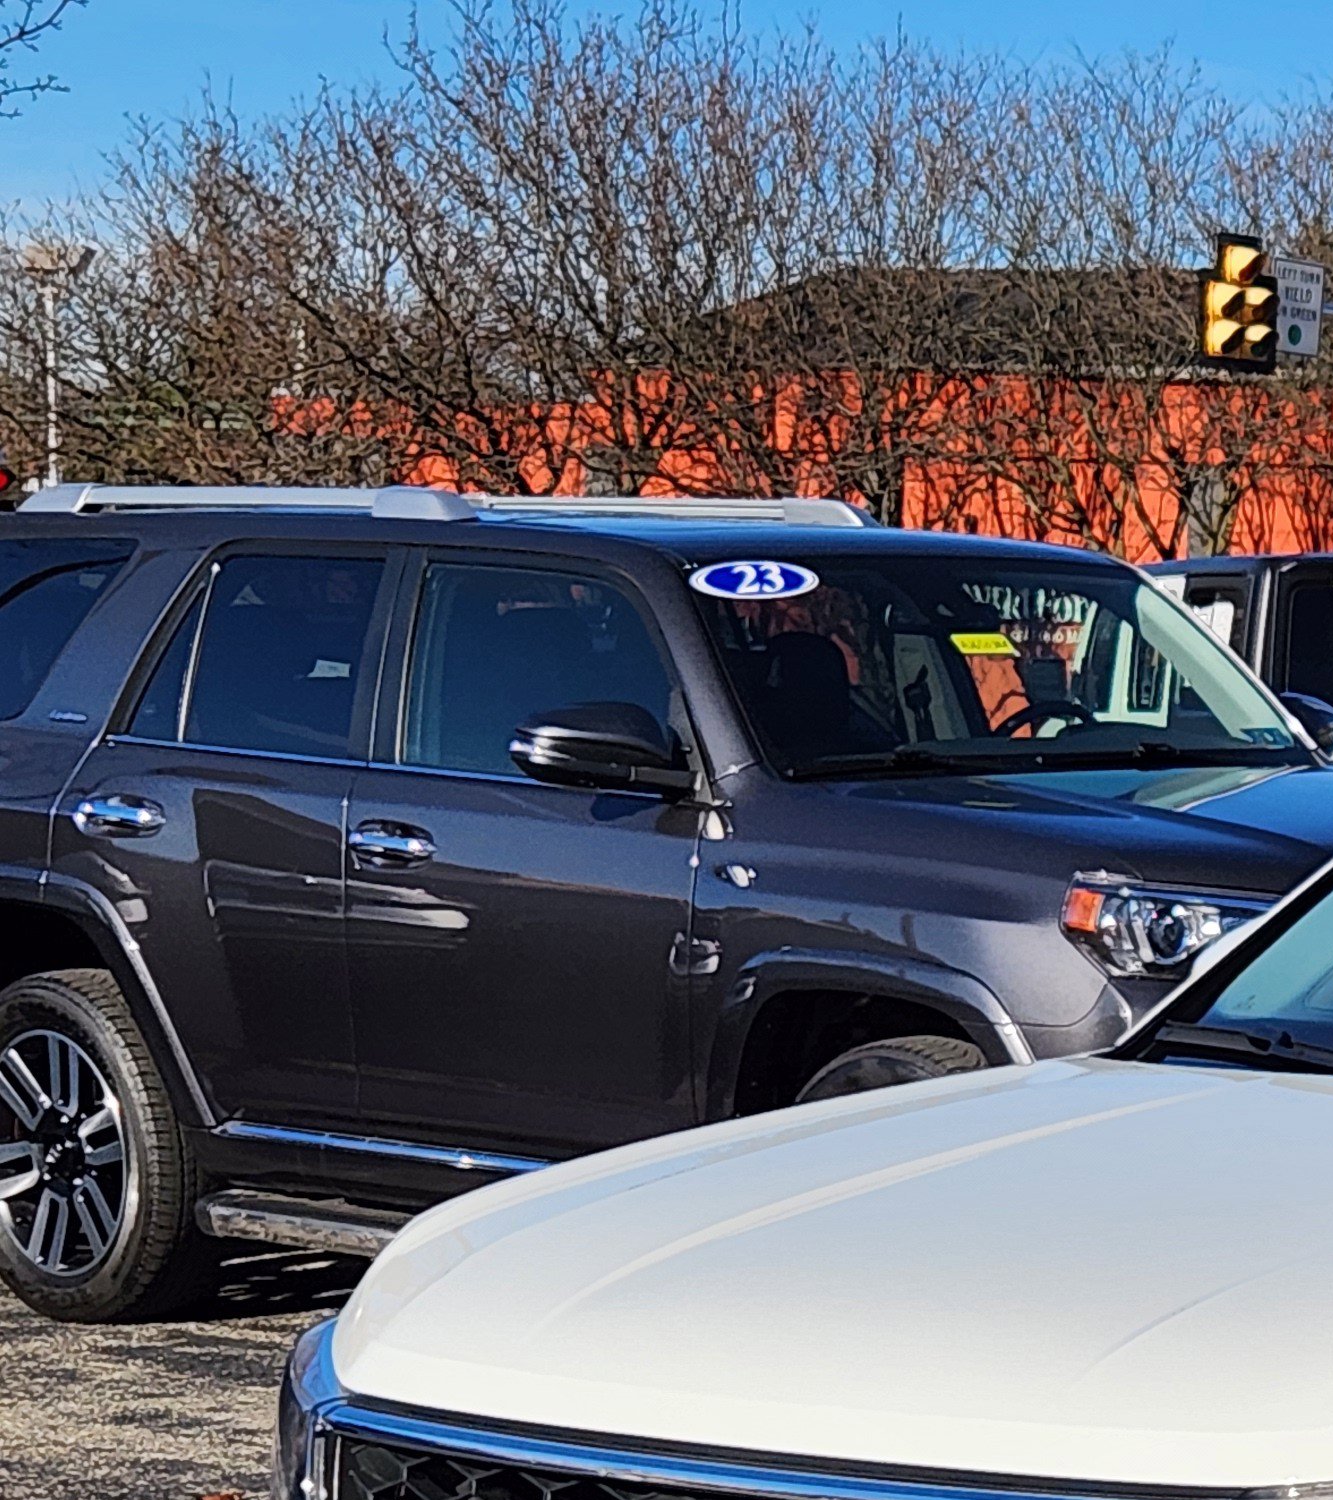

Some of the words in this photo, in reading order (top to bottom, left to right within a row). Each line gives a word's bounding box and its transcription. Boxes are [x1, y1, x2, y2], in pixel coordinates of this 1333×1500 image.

[1277, 266, 1297, 280] LEFT
[1299, 270, 1321, 284] TURN
[1284, 285, 1313, 303] YIELD
[1290, 306, 1317, 321] GREEN
[731, 561, 785, 594] 23
